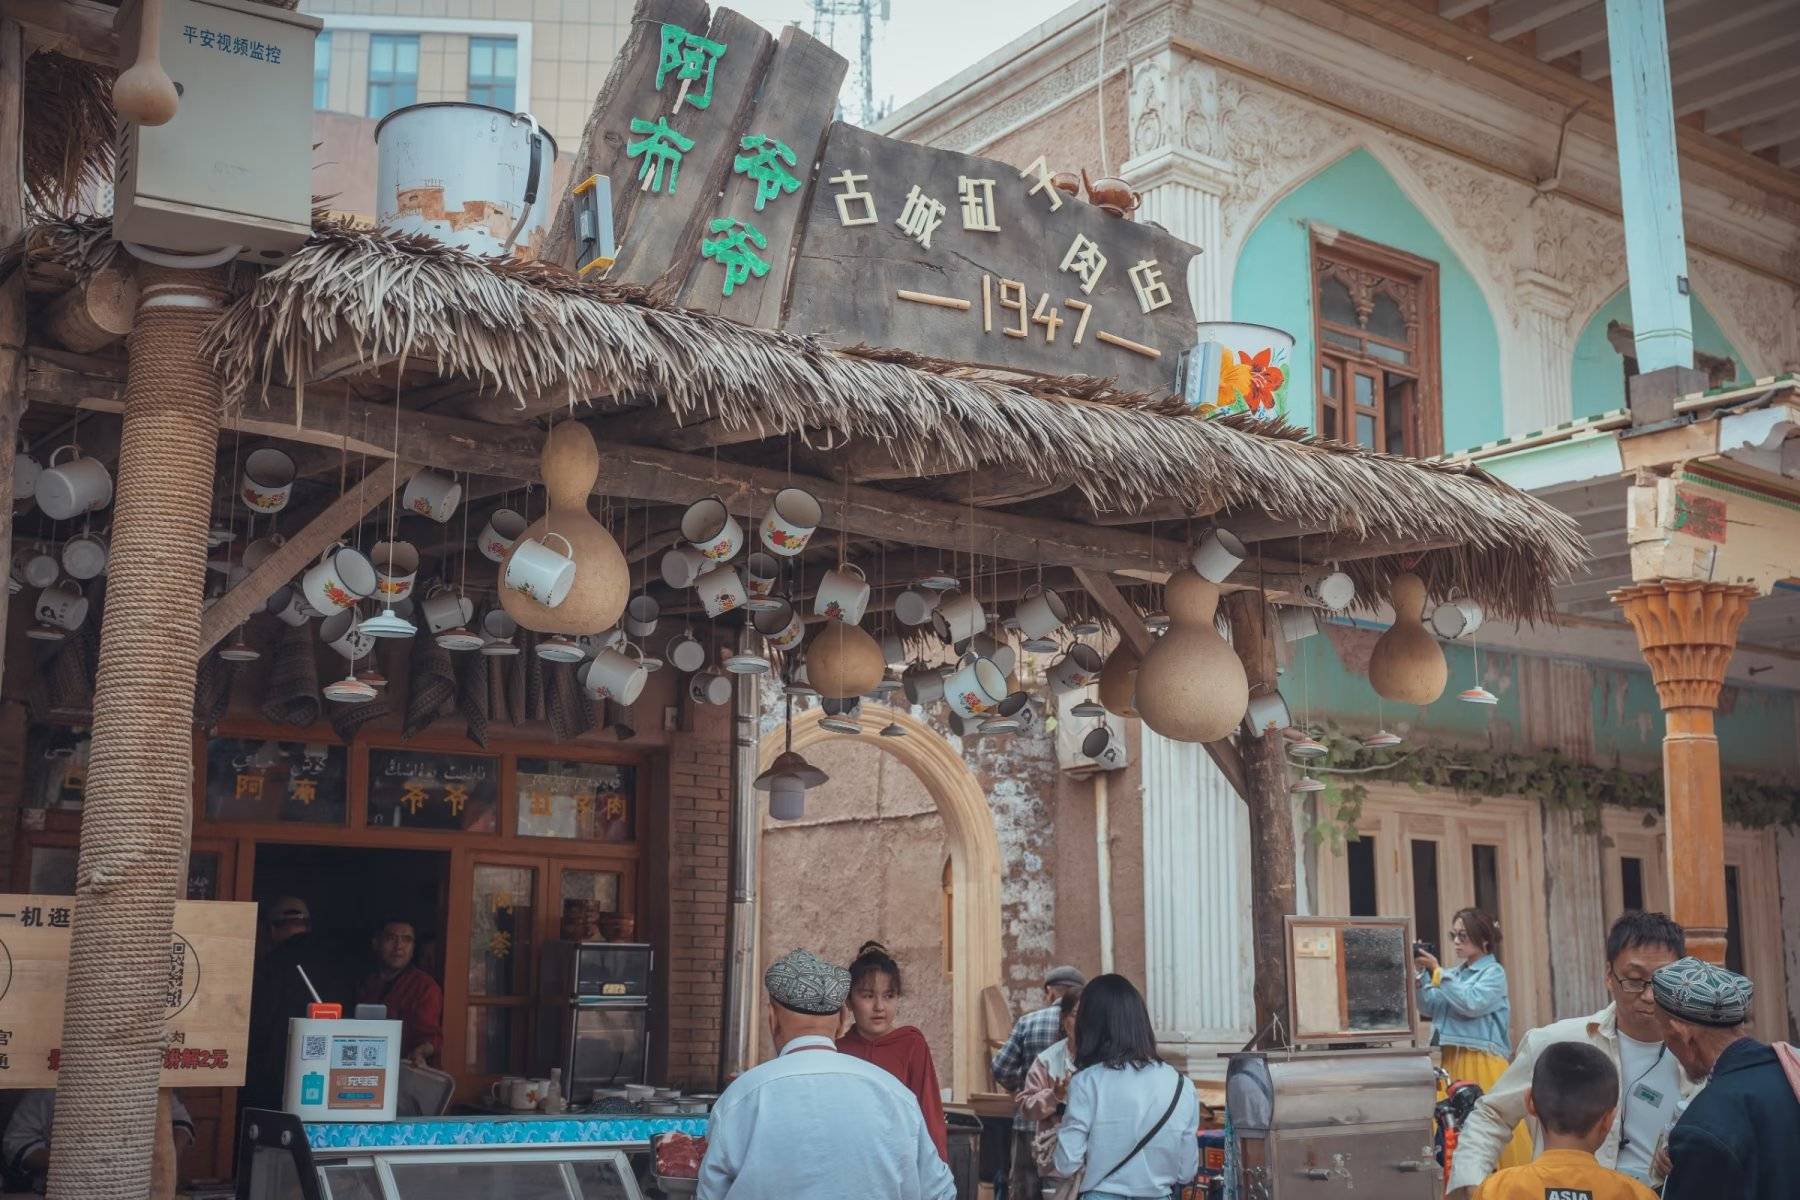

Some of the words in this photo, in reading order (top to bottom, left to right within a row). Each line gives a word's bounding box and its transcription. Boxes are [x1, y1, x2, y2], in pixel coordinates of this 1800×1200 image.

[183, 25, 281, 64] 平安视频监控
[626, 23, 727, 195] 阿布
[701, 133, 801, 297] 爷爷
[828, 155, 1173, 315] 古城缸子肉店
